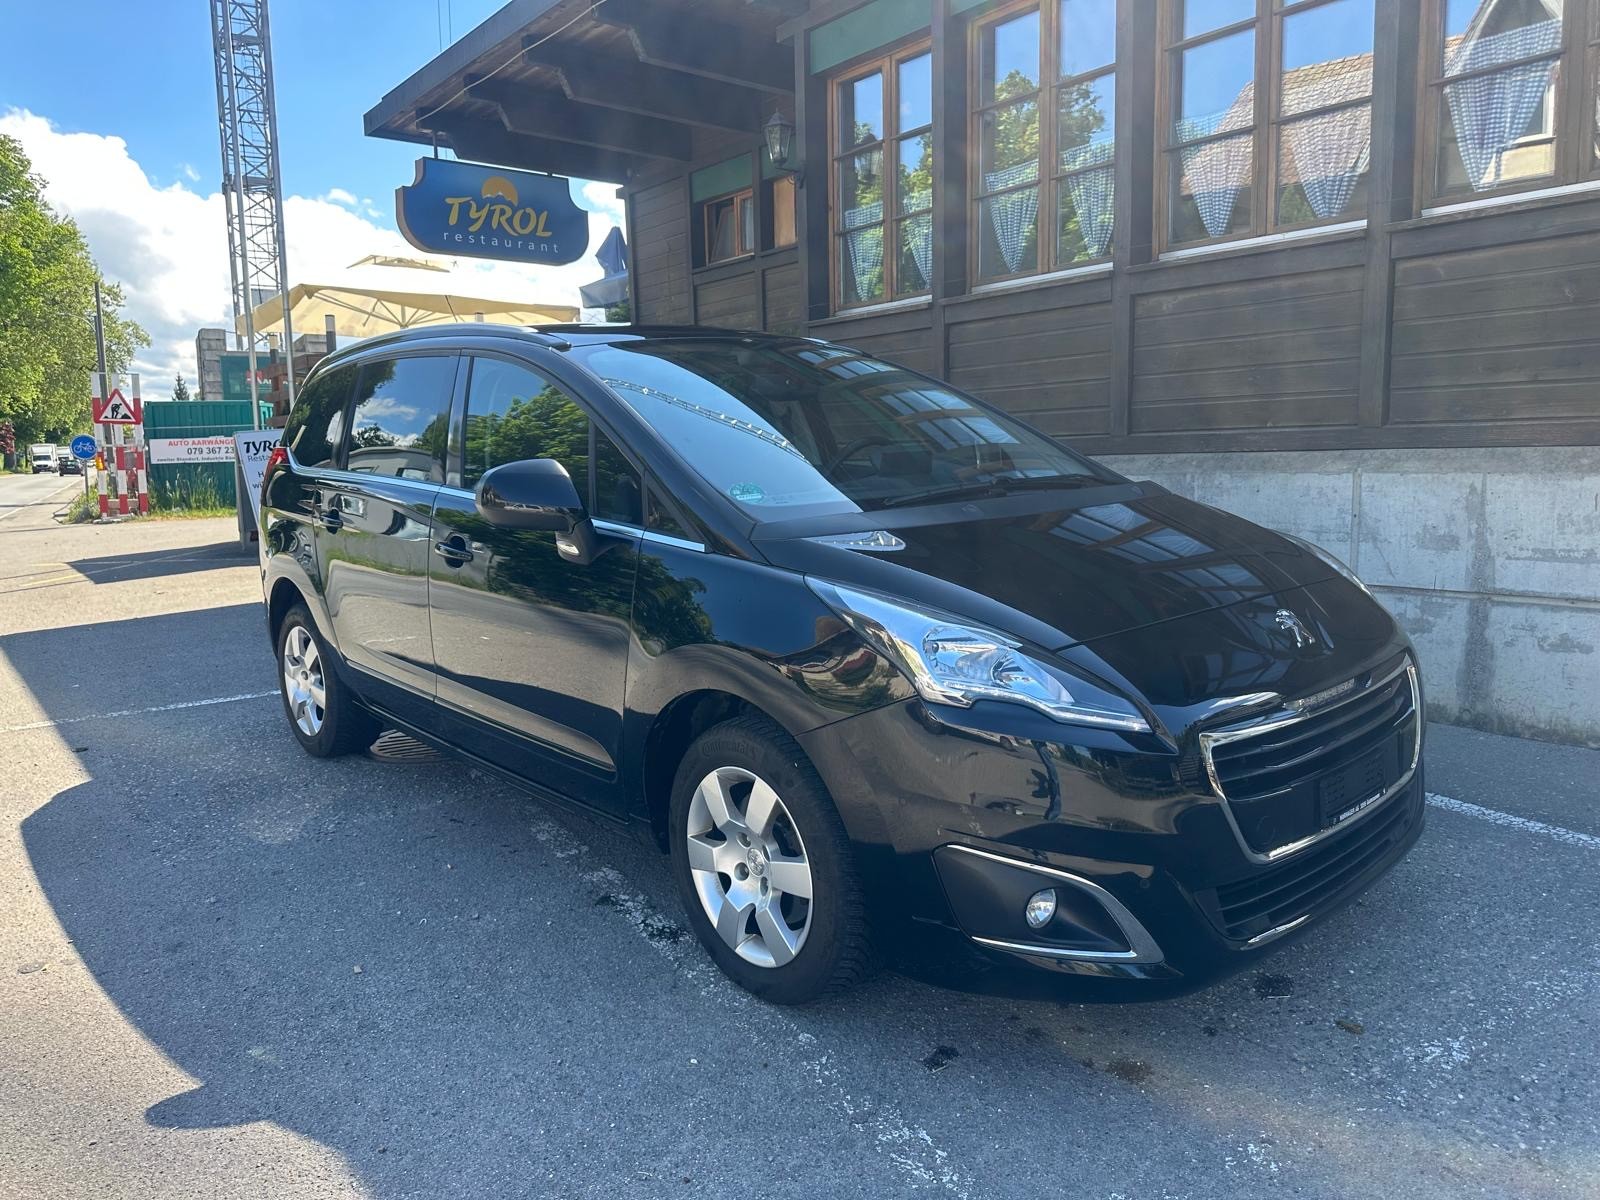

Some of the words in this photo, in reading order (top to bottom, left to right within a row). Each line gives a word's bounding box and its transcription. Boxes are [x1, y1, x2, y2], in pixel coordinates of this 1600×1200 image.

[445, 197, 552, 238] TYROL
[443, 231, 559, 253] restaurant
[192, 439, 235, 447] AARWANGE
[187, 447, 203, 455] 079
[206, 447, 222, 455] 367
